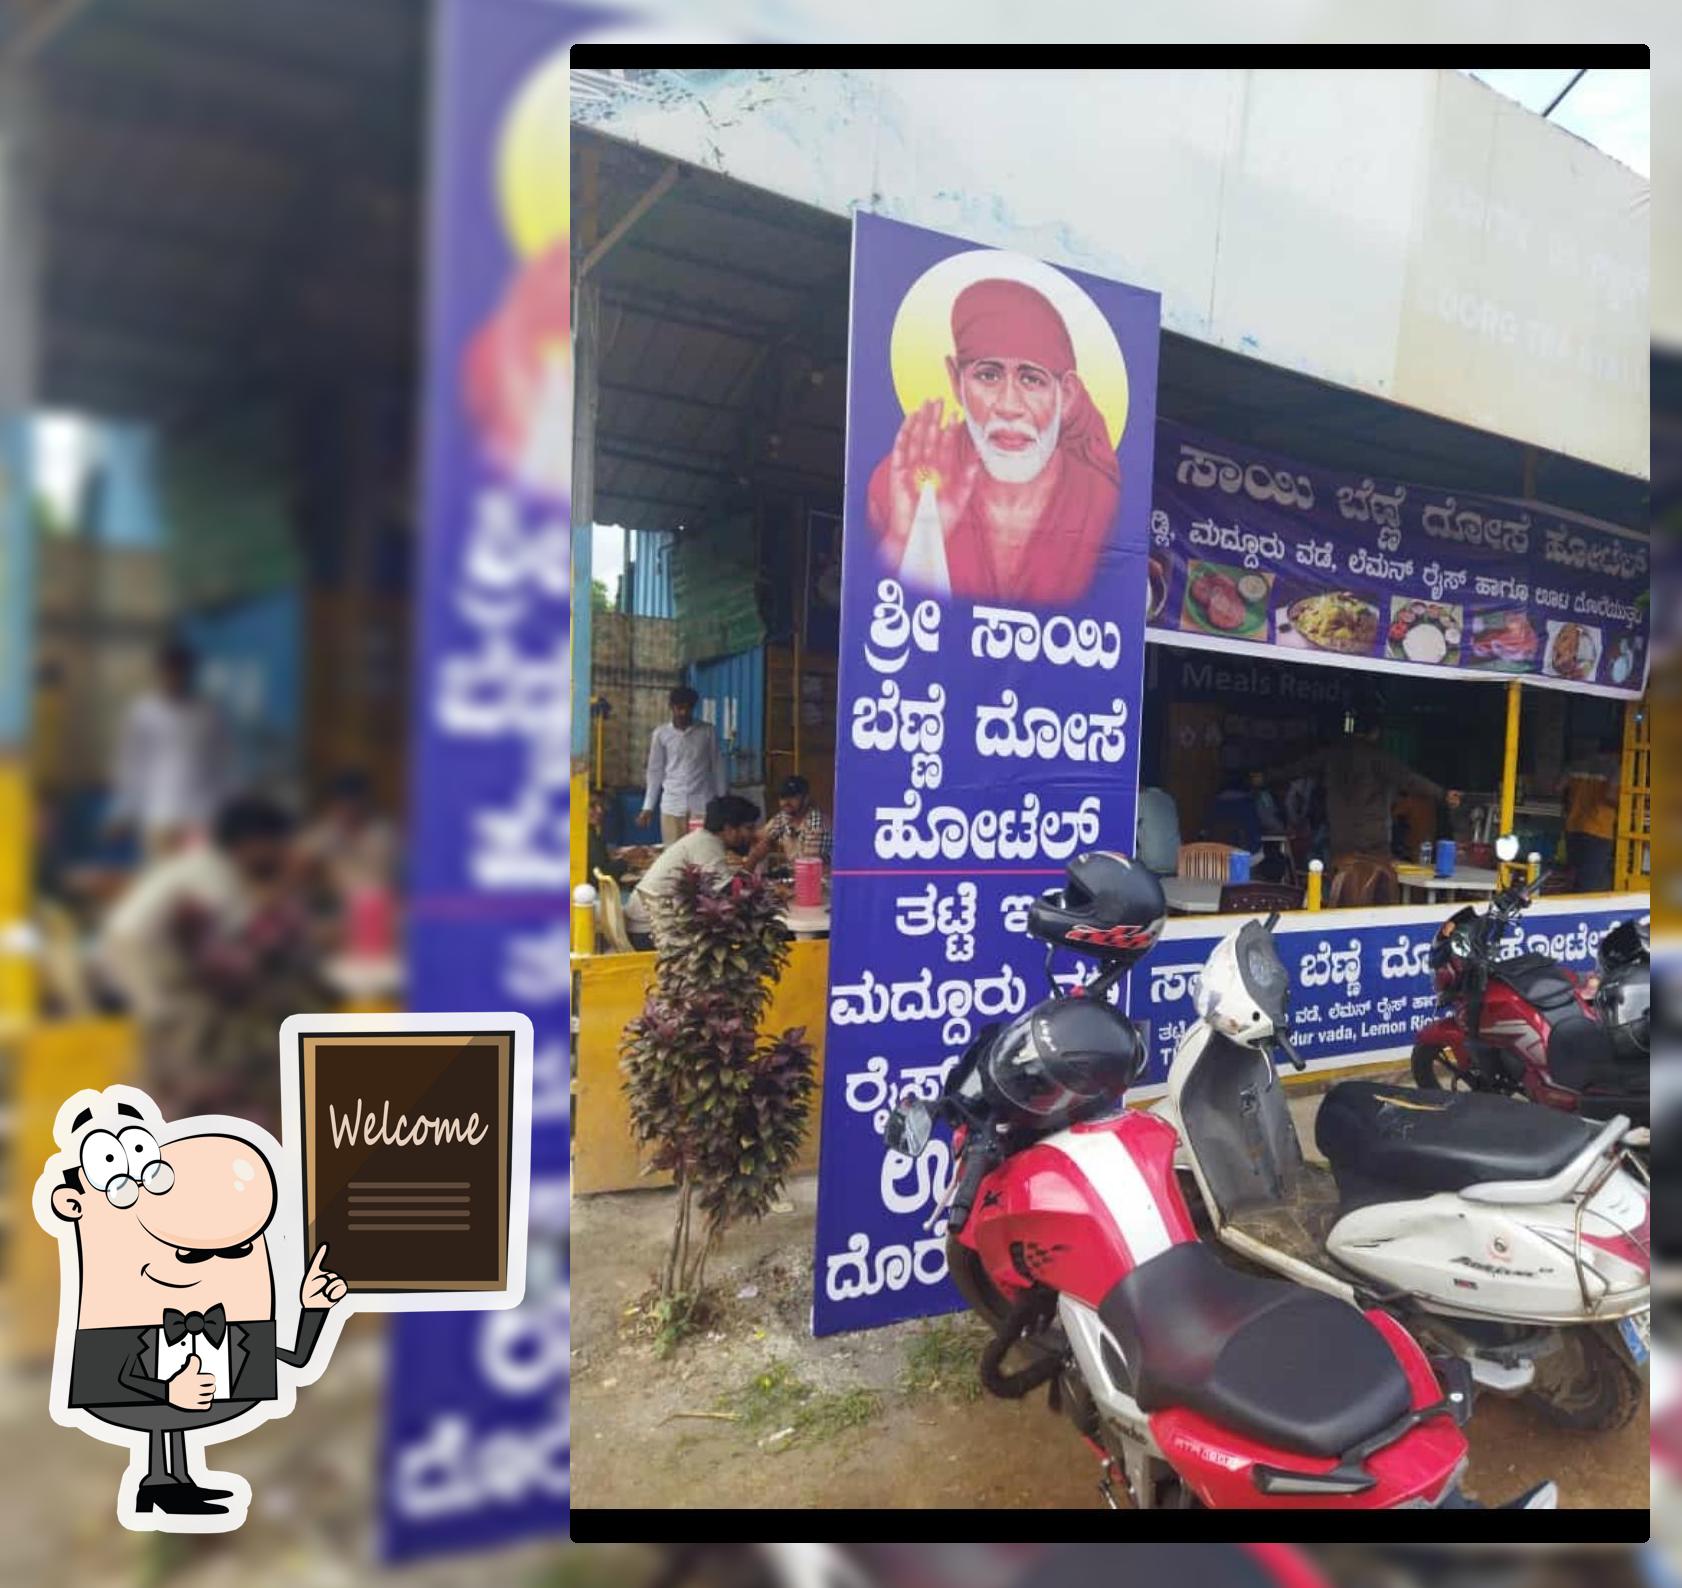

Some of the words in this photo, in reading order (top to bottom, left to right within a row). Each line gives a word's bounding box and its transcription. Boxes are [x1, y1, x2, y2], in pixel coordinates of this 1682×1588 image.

[1177, 445, 1315, 510] ಸಾಯಿ
[1336, 478, 1407, 552] ಬೆಣ್ಣೆ
[1422, 497, 1531, 553] ದೋಸೆ
[1151, 510, 1176, 548] ಡ್ಲಿ,
[1189, 518, 1285, 569] ಮದ್ದೂರು
[1422, 560, 1467, 600] ರೈಸ್
[1475, 574, 1529, 603] ಹಾಗೂ
[865, 578, 941, 673] ಶ್ರೀ
[971, 605, 1121, 670] ಸಾಯಿ
[852, 679, 946, 789] ಬೆಣ್ಣೆ
[975, 689, 1128, 762] ದೋಸೆ
[874, 789, 1100, 860] ಹೋಟೆಲ್
[896, 881, 978, 962] ತಟ್ಟೆ
[830, 963, 1027, 1046] ಮದ್ದೂರು
[1300, 939, 1362, 997] ಬೆಣ್ಣೆ
[1289, 1030, 1314, 1047] dur
[1318, 1024, 1357, 1043] vada,
[1361, 1019, 1406, 1038] Lemon
